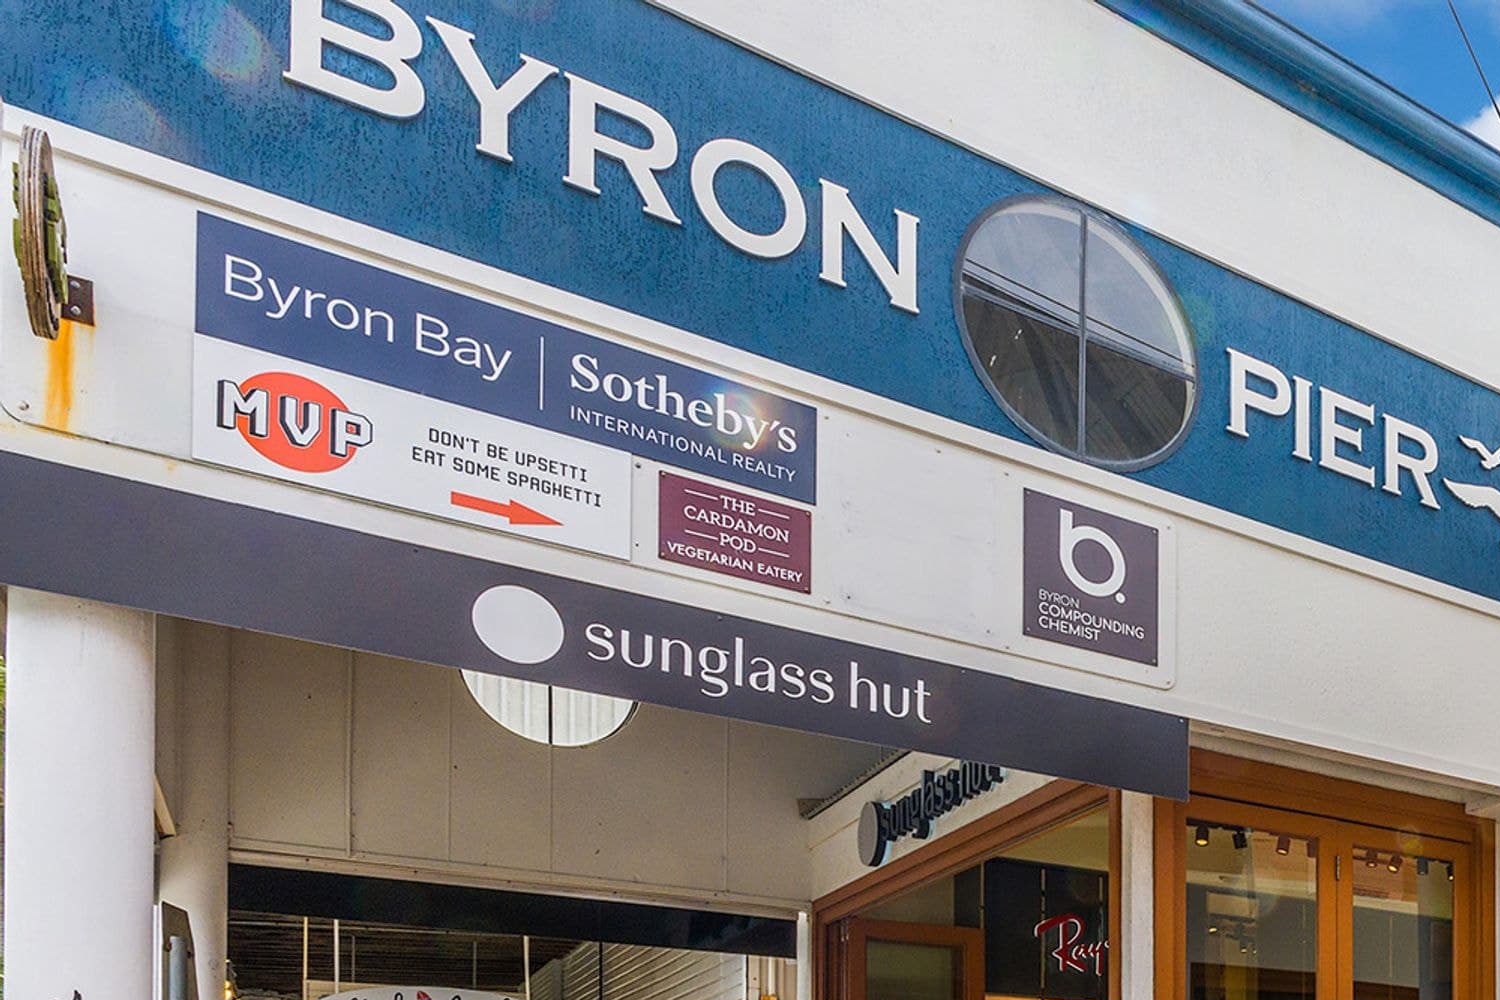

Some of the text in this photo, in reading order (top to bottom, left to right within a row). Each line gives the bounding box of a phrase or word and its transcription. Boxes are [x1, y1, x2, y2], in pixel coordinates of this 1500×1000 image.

[283, 0, 1441, 510] BYRON PIER
[225, 253, 513, 382] Byron Bay
[217, 379, 373, 457] MVP
[570, 353, 797, 453] Sotheby's
[429, 428, 588, 483] DON'T BE UPSETTI
[570, 405, 797, 482] INTERNATIONAL REALTY
[412, 446, 602, 508] EAT SOME SPAGHETTI
[719, 495, 756, 516] THE
[683, 505, 790, 543] CARDAMON
[719, 532, 757, 553] POD
[667, 540, 803, 584] VEGETARIAN EATERY
[1038, 588, 1080, 609] BYRON
[1038, 602, 1145, 640] COMPOUNDING
[1038, 616, 1101, 641] CHEMIST
[585, 622, 933, 724] sunglass hut
[879, 768, 961, 841] sunglass
